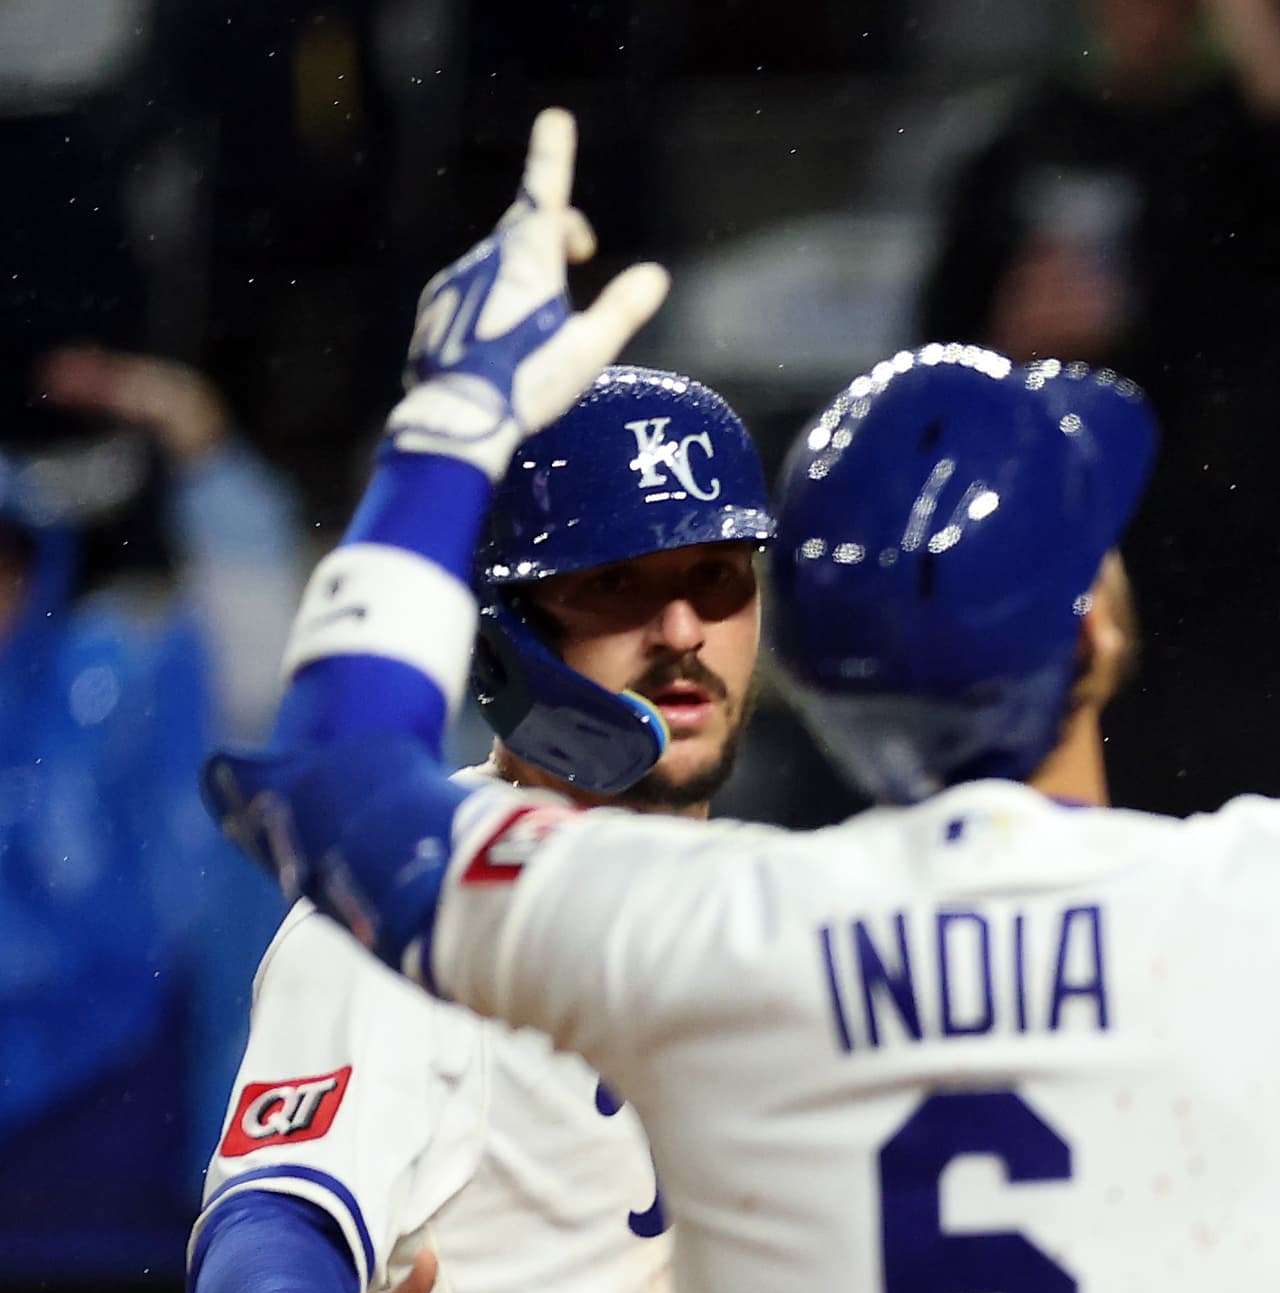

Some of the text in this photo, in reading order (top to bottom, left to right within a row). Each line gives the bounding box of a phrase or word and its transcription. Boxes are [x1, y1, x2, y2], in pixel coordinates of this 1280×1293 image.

[624, 416, 720, 500] KC
[821, 906, 1108, 1052] INDIA
[241, 1079, 338, 1139] QT
